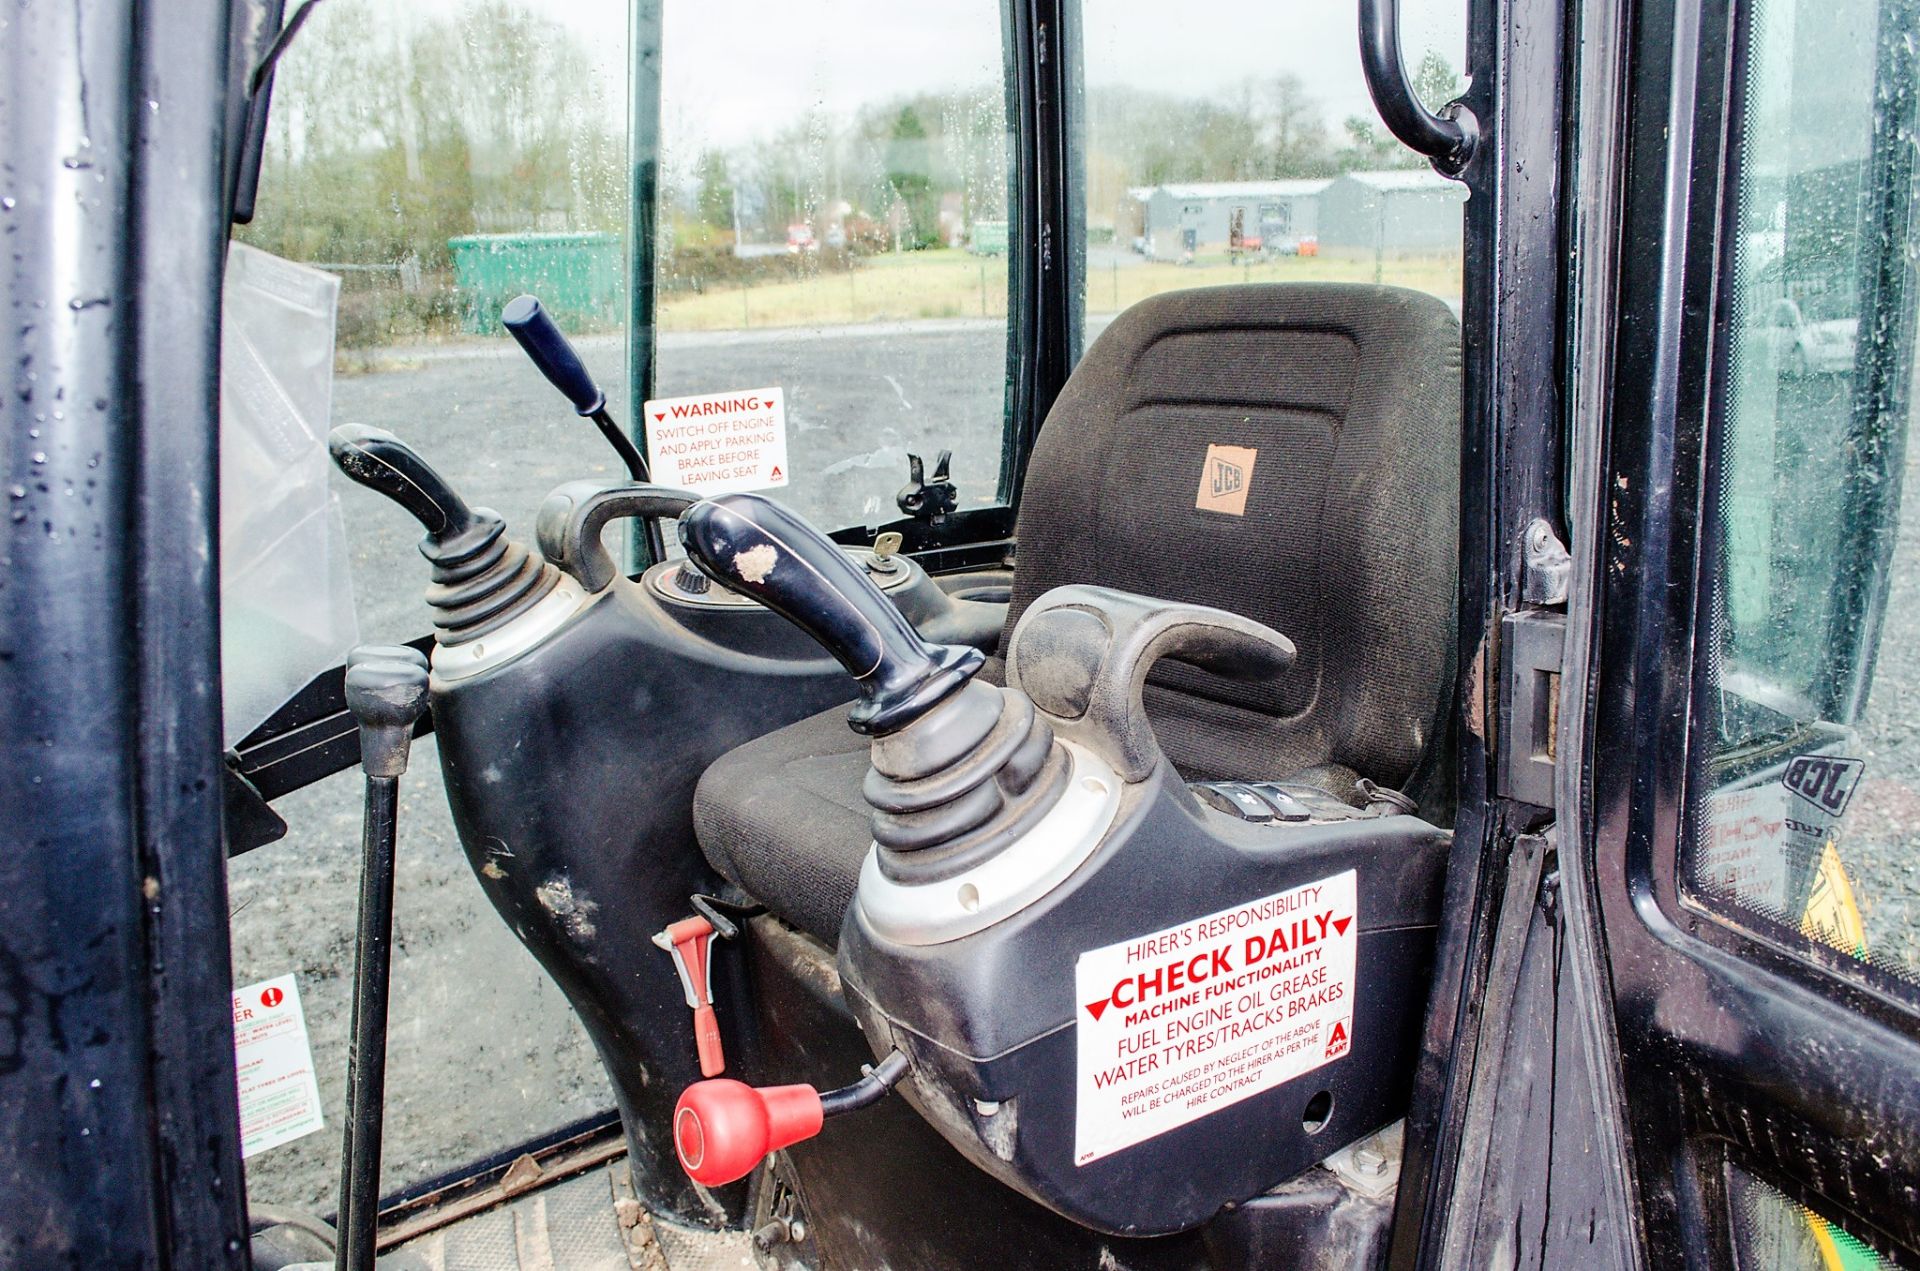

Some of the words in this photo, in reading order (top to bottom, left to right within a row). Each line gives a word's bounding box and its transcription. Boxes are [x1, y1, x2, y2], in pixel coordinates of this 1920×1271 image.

[671, 398, 759, 418] WARNING
[656, 426, 704, 440] SWITCH
[708, 422, 729, 433] OFF
[733, 416, 775, 430] ENGINE
[659, 444, 687, 456] AND
[690, 439, 722, 452] APPLY
[726, 432, 775, 446] PARKING
[678, 455, 715, 469] BRAKE
[719, 450, 760, 464] BEFORE
[682, 469, 730, 485] LEAVING
[734, 465, 759, 477] SEAT
[1214, 463, 1240, 492] JCB
[1127, 928, 1192, 964] HIRER'S
[1199, 886, 1323, 941] RESPONSIBILITY
[1111, 945, 1232, 1009] CHECK
[1245, 910, 1334, 965] DAILY
[1125, 991, 1200, 1027] MACHINE
[1205, 948, 1322, 1000] FUNCTIONALITY
[1117, 1026, 1160, 1058] FUEL
[1167, 1001, 1232, 1040] ENGINE
[1238, 993, 1264, 1013] OIL
[1270, 967, 1327, 1000] GREASE
[1094, 1052, 1165, 1089] WATER
[1163, 1006, 1283, 1065] TYRES/TRACKS
[1288, 983, 1343, 1019] BRAKES
[1325, 1042, 1347, 1058] PLANT
[1328, 1022, 1347, 1046] A
[1122, 1084, 1160, 1106] REPAIRS
[1162, 1073, 1200, 1093] CAUSED
[1203, 1062, 1216, 1074] BY
[1218, 1045, 1258, 1067] NEGLECT
[1262, 1040, 1273, 1051] OF
[1276, 1033, 1291, 1047] THE
[1293, 1019, 1320, 1042] ABOVE
[1122, 1104, 1147, 1120] WILL
[1149, 1099, 1161, 1110] BE
[1164, 1079, 1211, 1105] CHARGED
[1213, 1073, 1225, 1083] TO
[1229, 1065, 1245, 1079] THE
[1248, 1053, 1272, 1071] HIRER
[1275, 1049, 1284, 1061] AS
[1286, 1043, 1300, 1057] PER
[1302, 1034, 1318, 1051] THE
[1186, 1093, 1208, 1109] HIRE
[1211, 1070, 1262, 1099] CONTRACT
